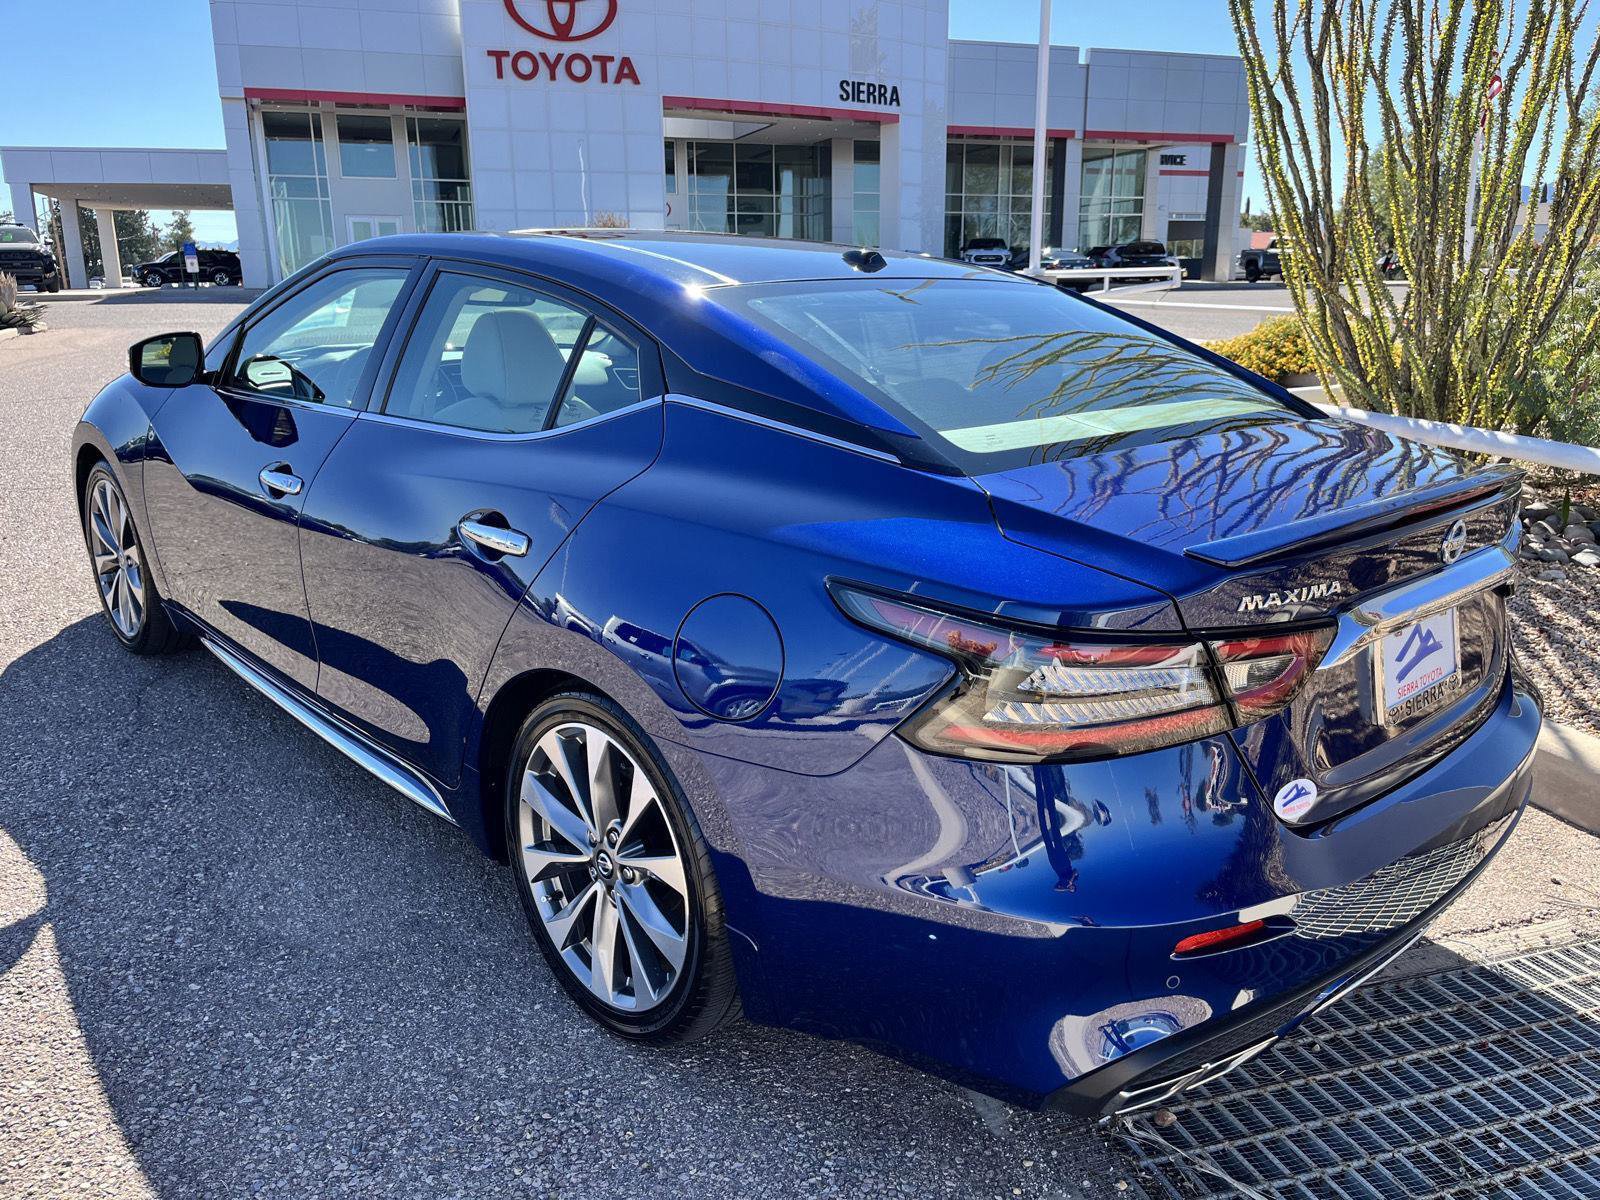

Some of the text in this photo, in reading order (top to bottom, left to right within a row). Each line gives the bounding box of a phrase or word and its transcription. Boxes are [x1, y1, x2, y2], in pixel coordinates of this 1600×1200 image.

[486, 50, 640, 85] TOYOTA
[838, 79, 901, 107] SIERRA
[1238, 580, 1342, 612] MAXIMA
[1397, 666, 1443, 698] SIERRA TOYOTA
[1405, 682, 1444, 716] SIERRA
